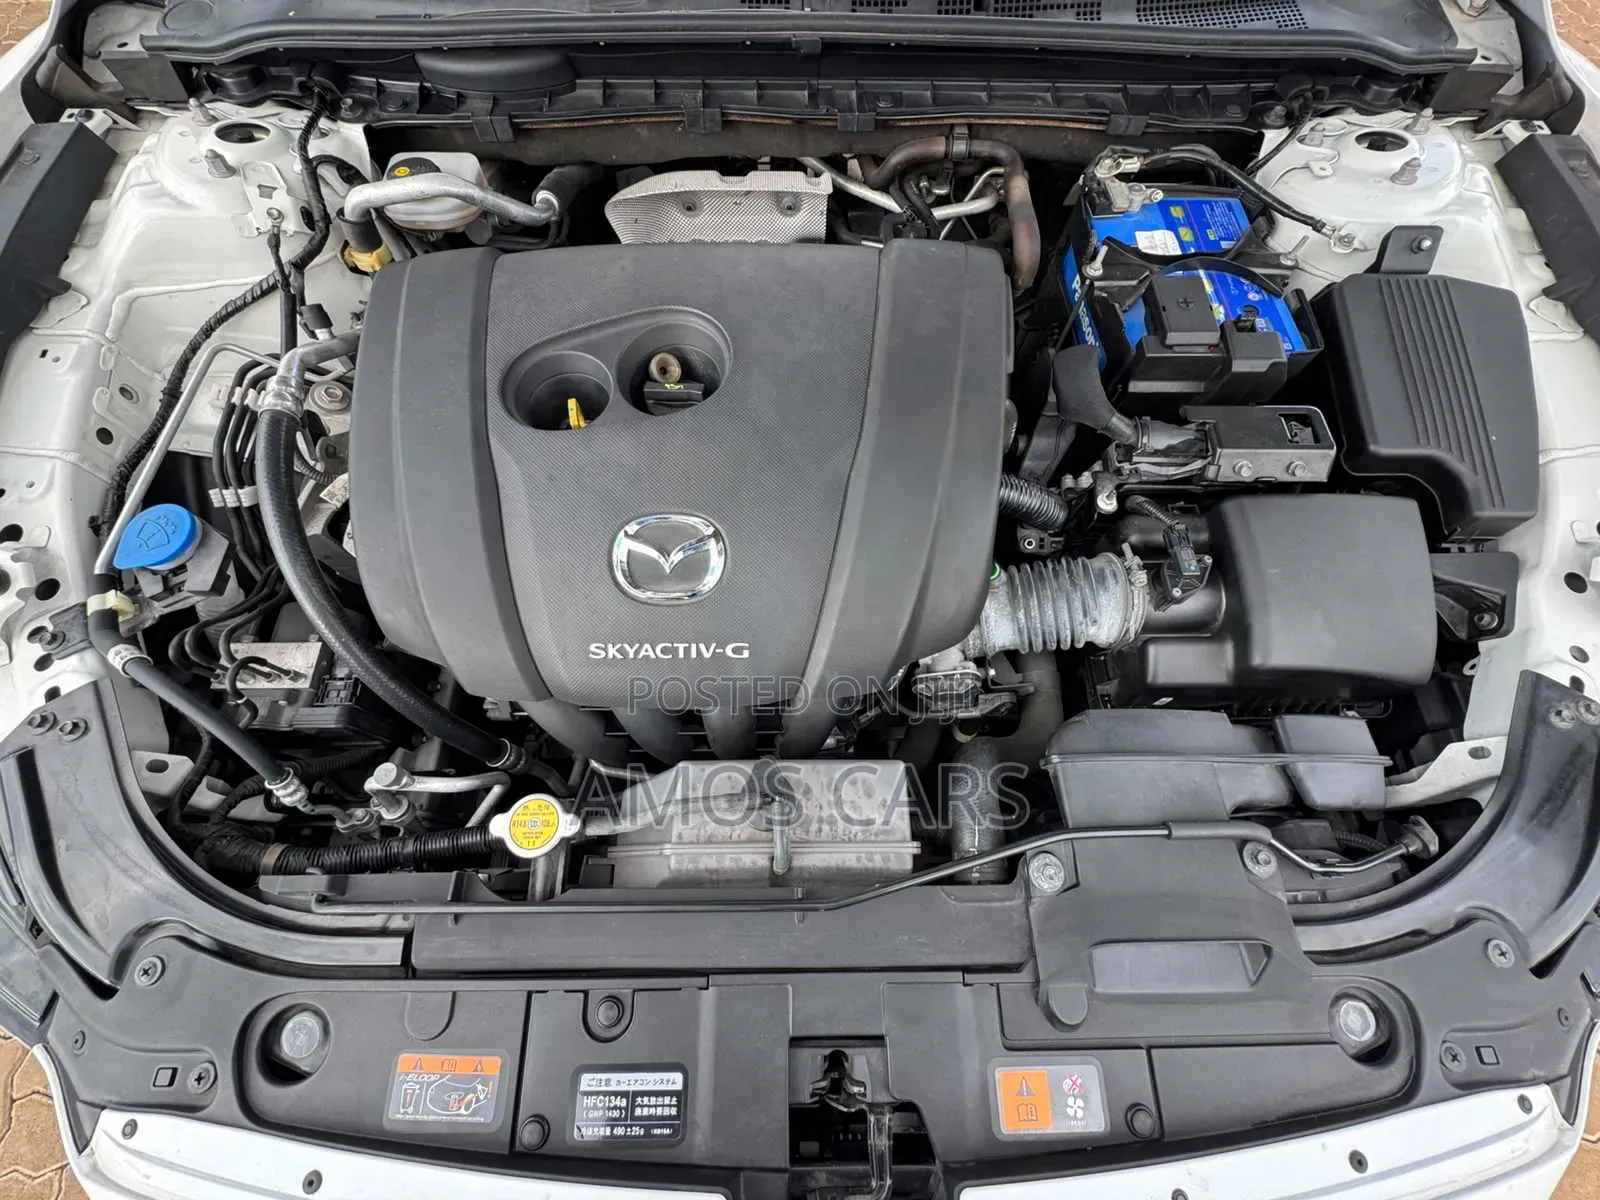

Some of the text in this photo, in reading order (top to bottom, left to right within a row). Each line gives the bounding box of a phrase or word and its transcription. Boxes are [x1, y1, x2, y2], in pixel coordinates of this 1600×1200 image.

[589, 643, 749, 659] SKYACTIV-G
[587, 1077, 612, 1087] ご注意
[583, 1095, 627, 1108] HFC134a
